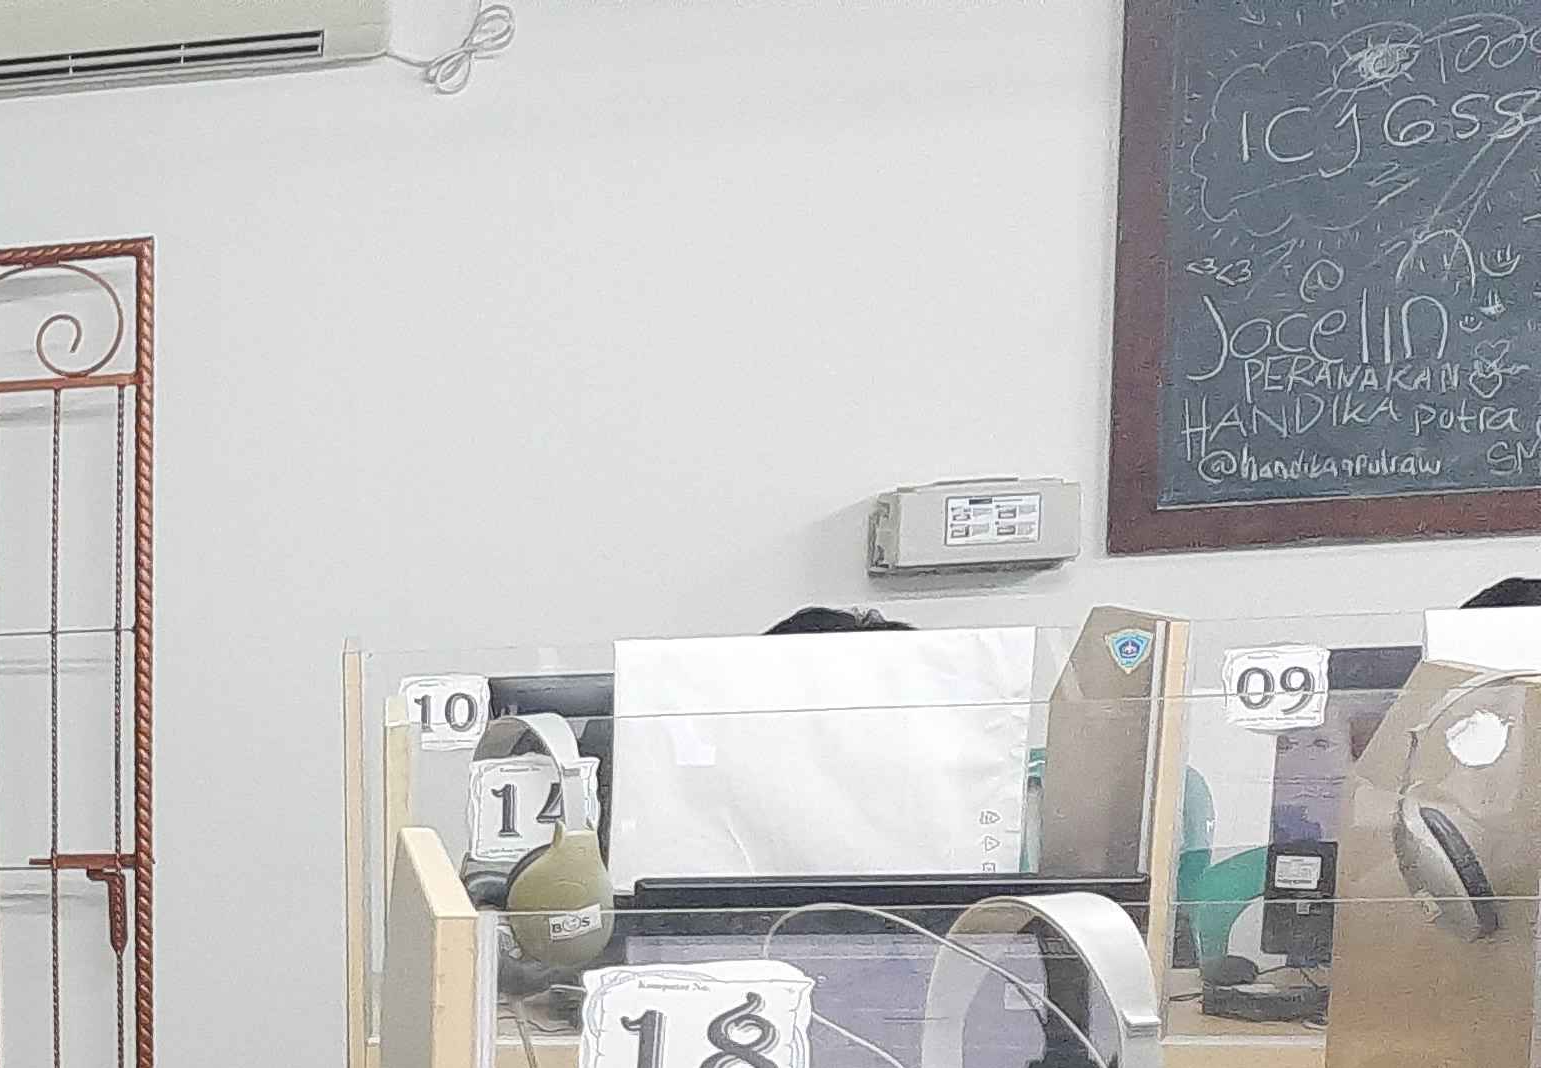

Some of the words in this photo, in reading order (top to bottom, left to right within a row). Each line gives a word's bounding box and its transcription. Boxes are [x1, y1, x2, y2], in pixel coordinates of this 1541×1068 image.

[1243, 354, 1461, 403] PERANAKAN
[414, 692, 478, 733] 10
[1236, 666, 1316, 716] 09
